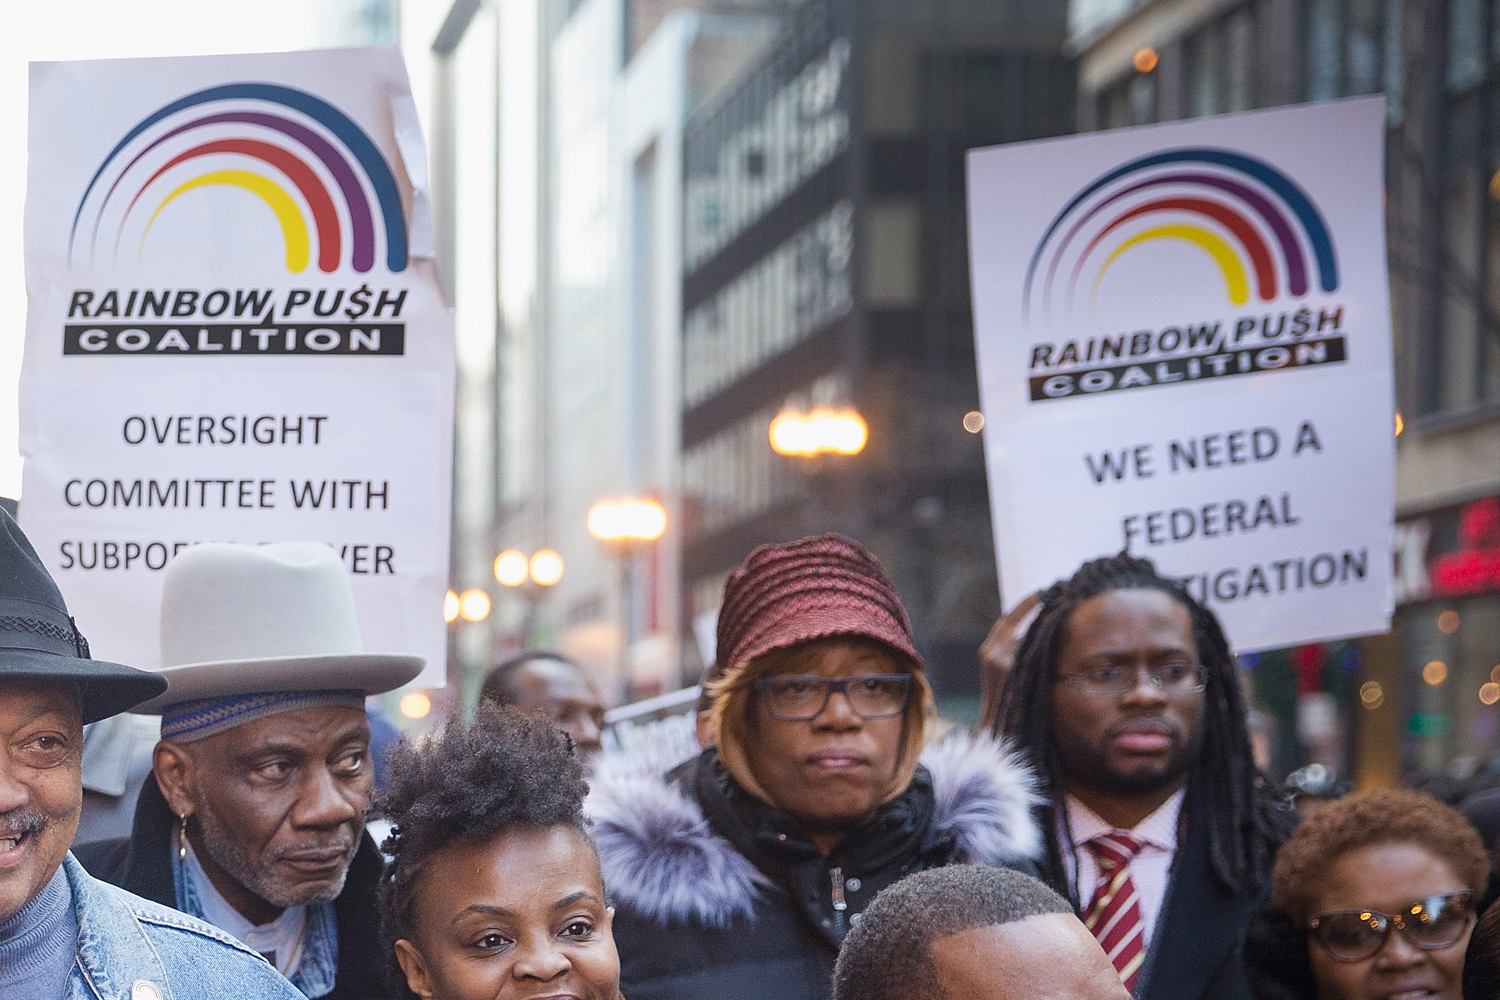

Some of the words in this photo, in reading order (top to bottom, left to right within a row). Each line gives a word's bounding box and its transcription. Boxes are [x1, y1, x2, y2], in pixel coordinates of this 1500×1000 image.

[77, 327, 383, 351] COALITION
[1041, 341, 1328, 398] COALITION
[122, 416, 329, 446] OVERSIGHT
[1085, 444, 1154, 483] WE
[1169, 426, 1280, 472] NEED
[1292, 418, 1322, 454] A
[63, 478, 276, 509] COMMITTEE
[290, 479, 389, 510] WITH
[1122, 492, 1301, 546] FEDERAL
